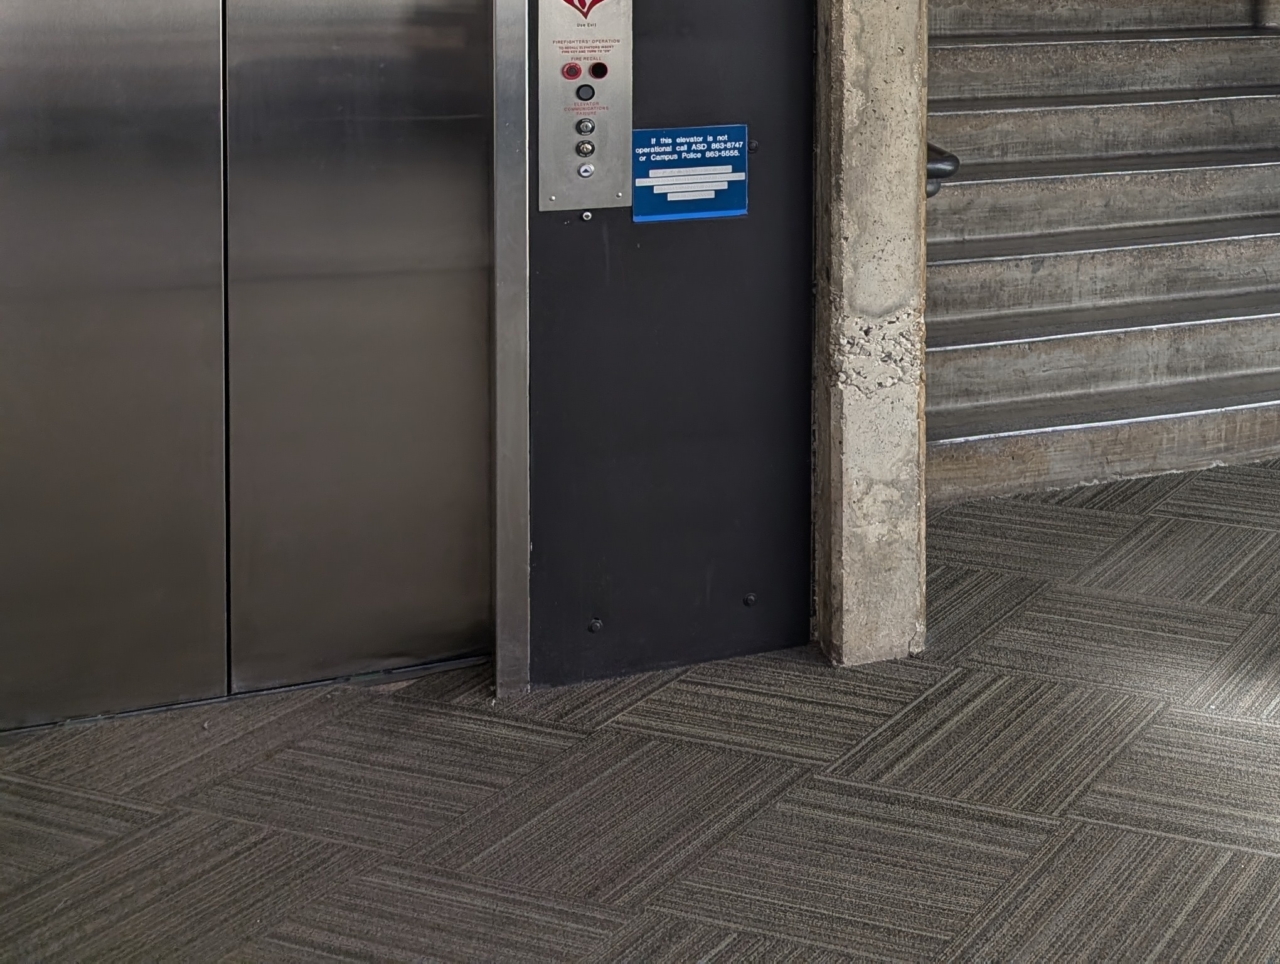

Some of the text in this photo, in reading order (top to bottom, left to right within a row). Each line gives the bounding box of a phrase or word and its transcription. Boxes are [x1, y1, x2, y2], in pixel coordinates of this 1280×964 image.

[651, 137, 656, 145] If
[676, 136, 703, 144] elevator
[636, 145, 672, 154] operational
[691, 143, 707, 151] ASD
[711, 141, 744, 149] 863-8747
